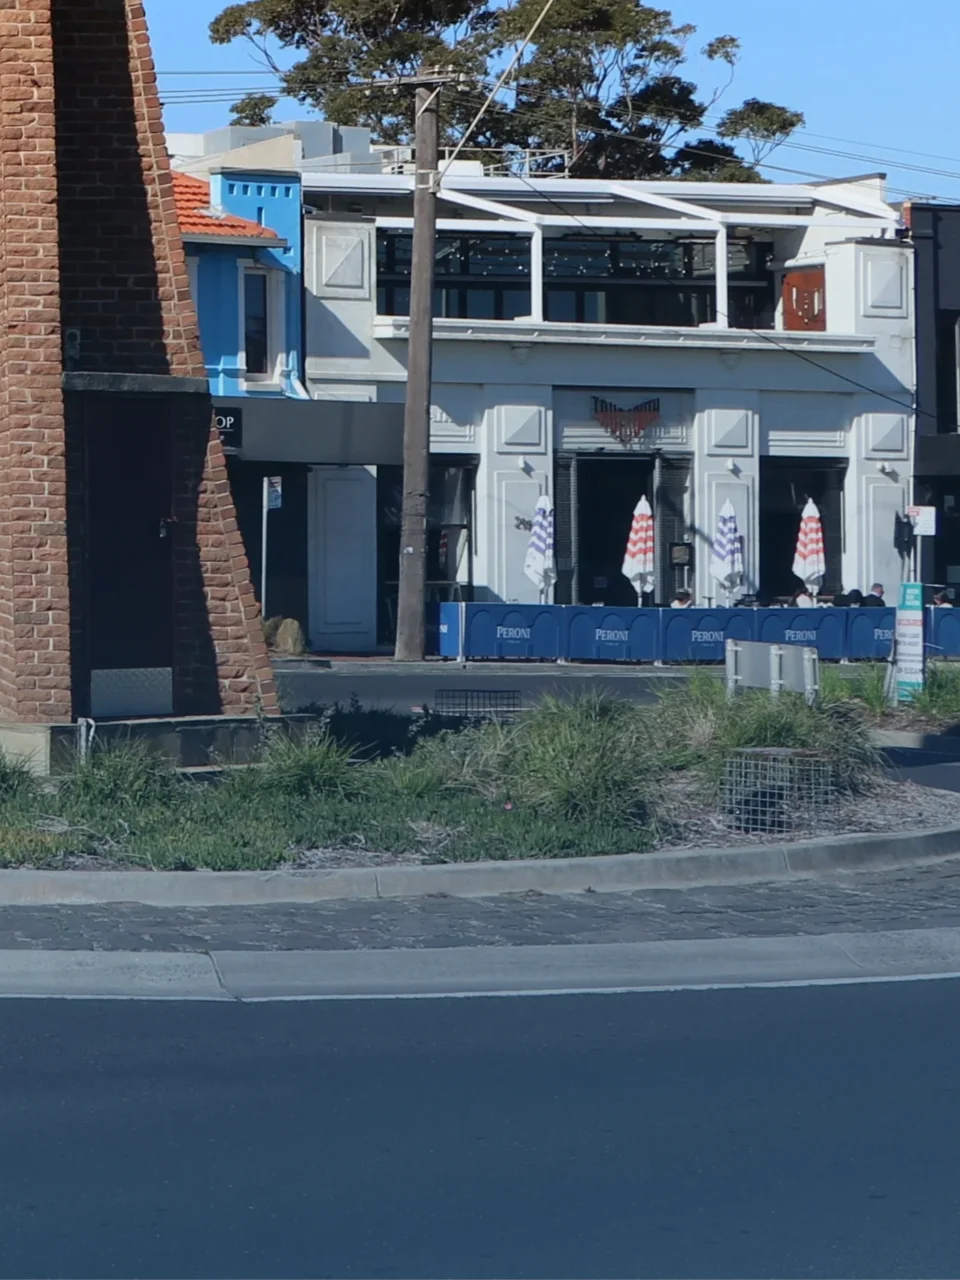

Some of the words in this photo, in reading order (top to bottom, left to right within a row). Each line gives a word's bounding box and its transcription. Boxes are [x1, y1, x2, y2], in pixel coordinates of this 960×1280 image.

[215, 416, 235, 429] OP
[496, 625, 531, 639] PERONI
[595, 628, 629, 641] PERONI
[691, 629, 724, 642] PERONI
[785, 629, 816, 641] PERONI
[874, 628, 894, 640] PERO
